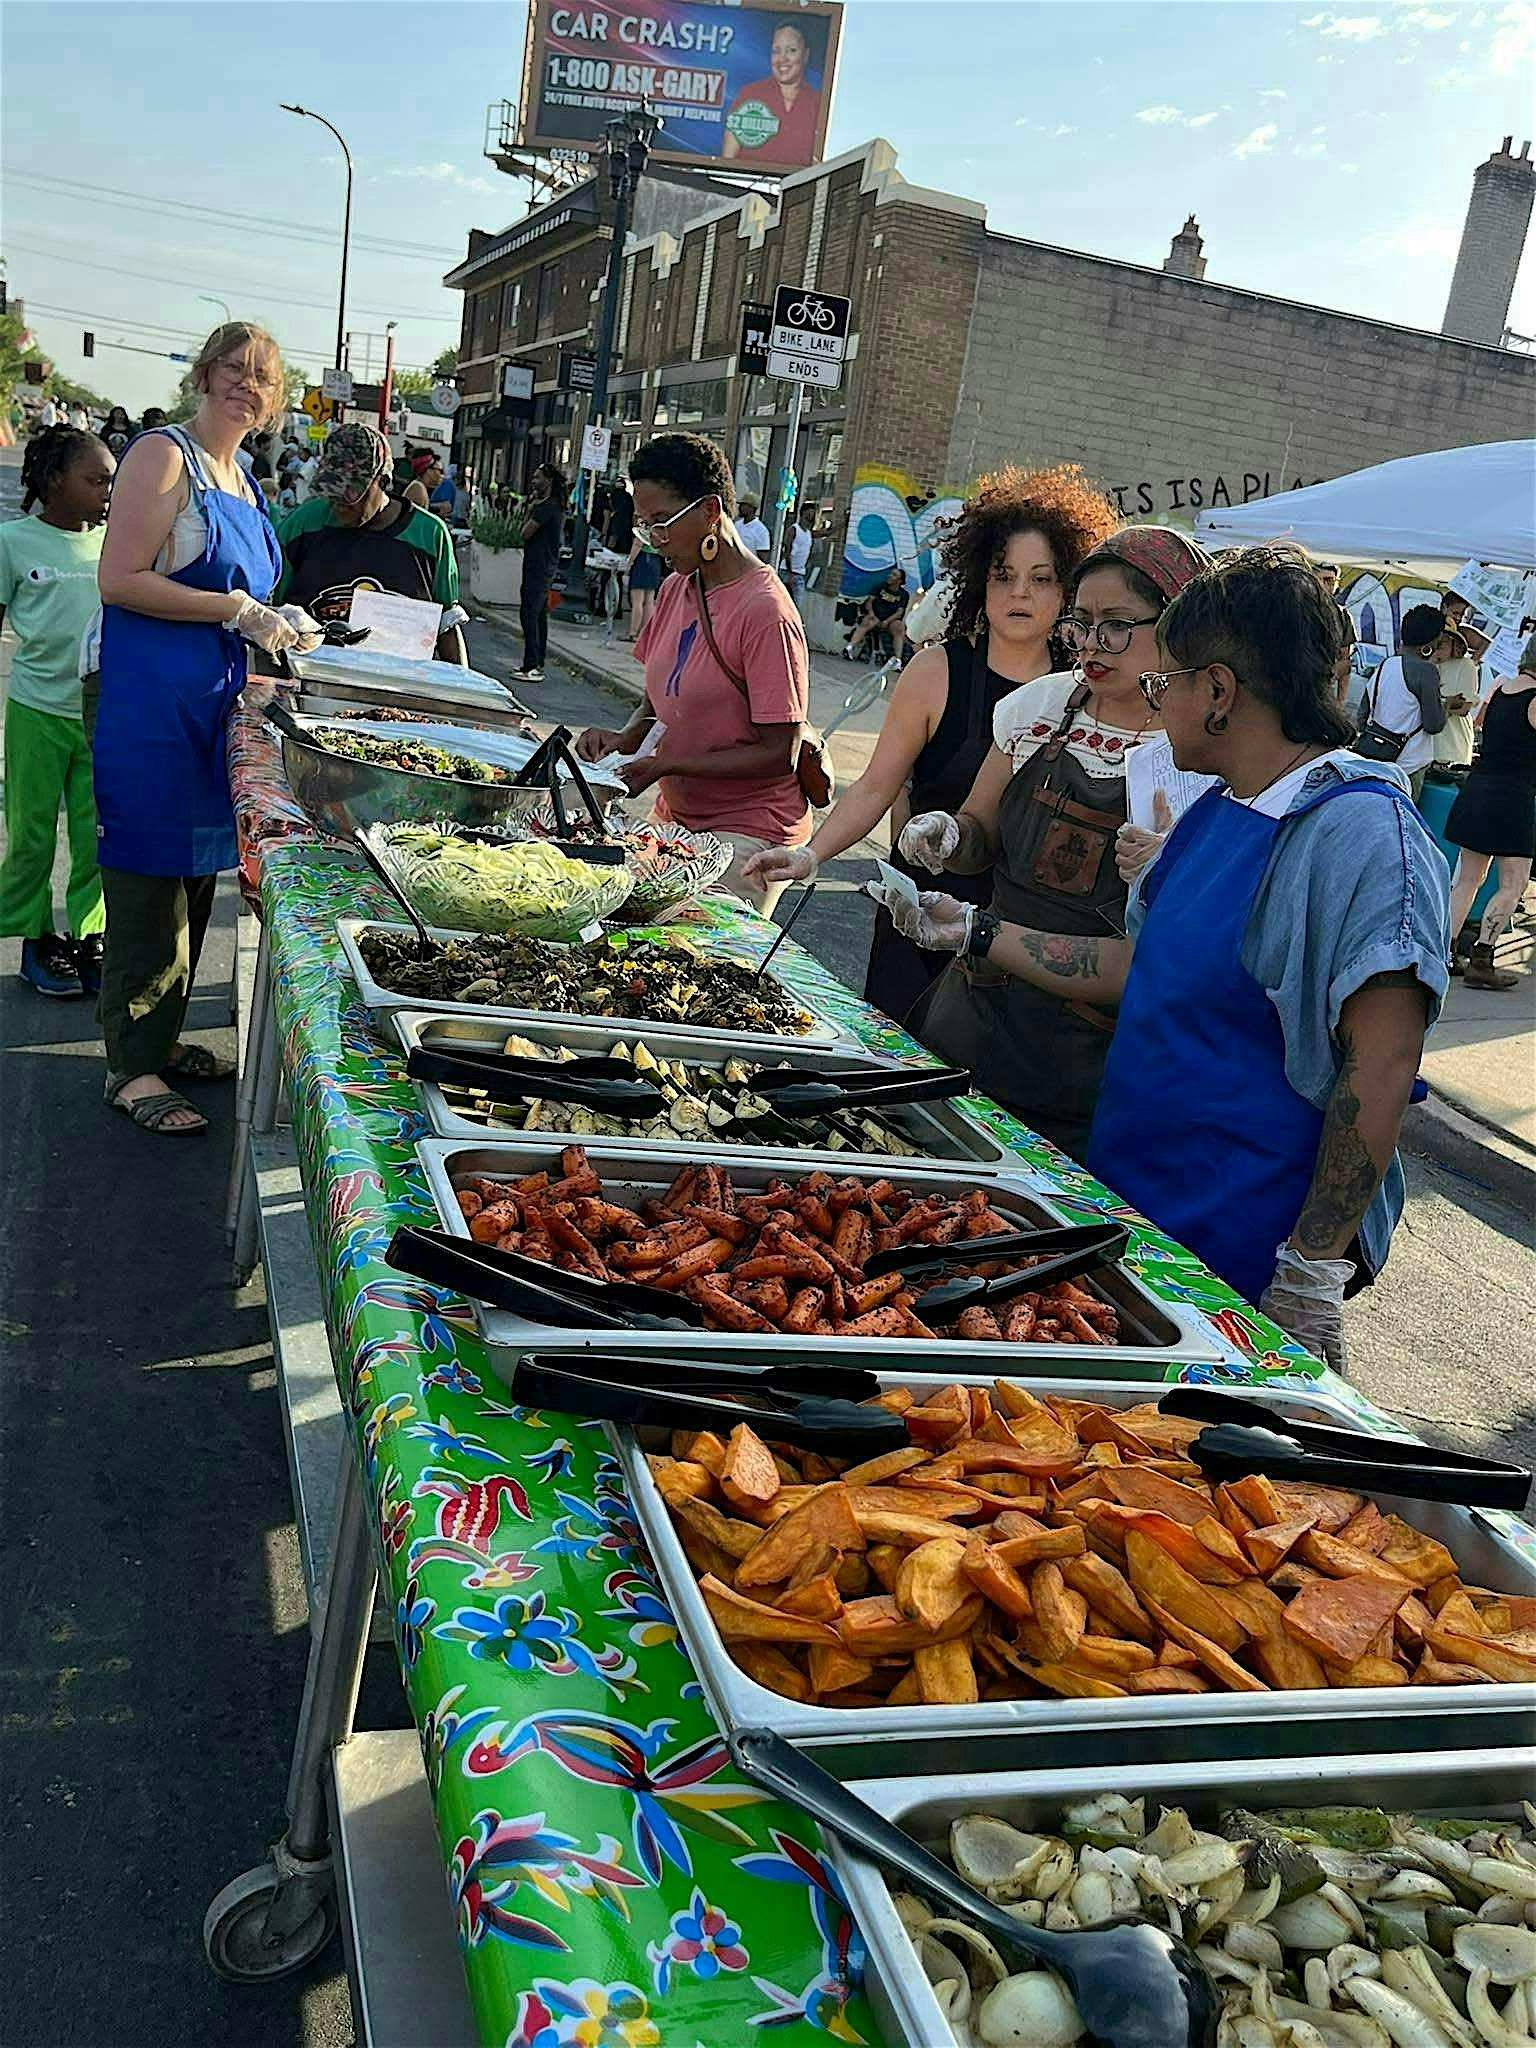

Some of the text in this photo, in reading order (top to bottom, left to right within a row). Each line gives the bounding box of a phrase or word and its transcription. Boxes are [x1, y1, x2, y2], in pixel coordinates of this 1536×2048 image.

[551, 9, 733, 53] CAR CRASH?
[550, 58, 722, 102] 1-800 ASK-GARY
[746, 329, 769, 348] PL
[780, 331, 836, 352] BIKE LANE
[745, 346, 769, 357] GALL
[789, 361, 819, 378] ENDS
[1106, 482, 1154, 518] IS
[1166, 477, 1203, 510] IS
[1212, 476, 1232, 507] A
